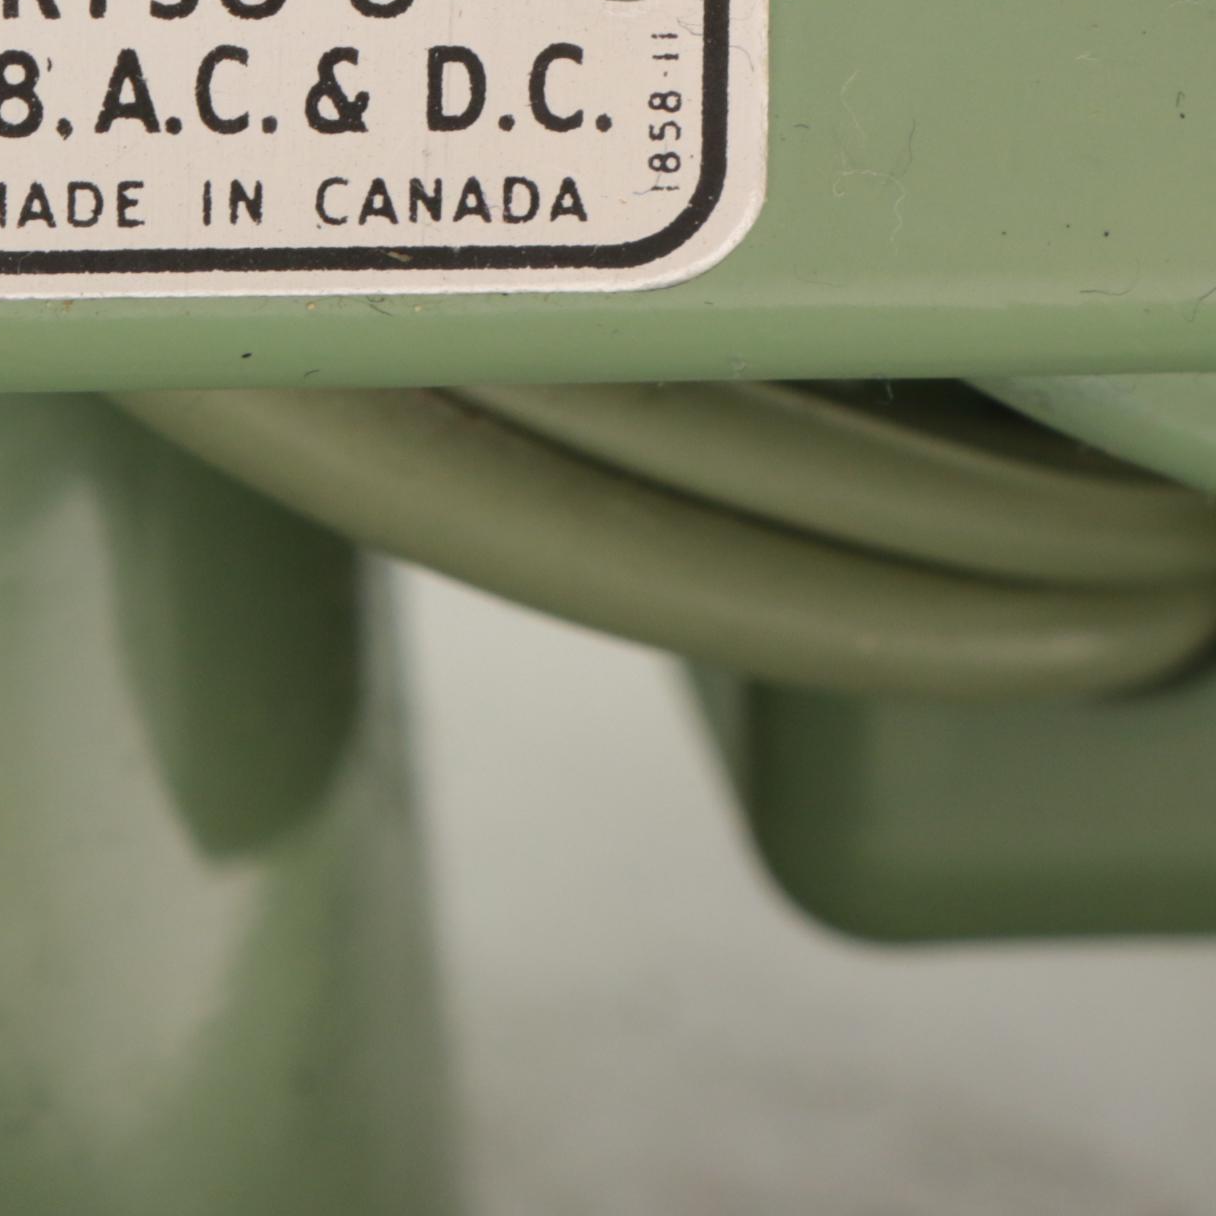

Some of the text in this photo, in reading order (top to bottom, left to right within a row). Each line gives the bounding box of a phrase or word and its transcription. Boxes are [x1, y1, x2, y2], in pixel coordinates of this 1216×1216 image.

[426, 42, 612, 133] D.C.
[202, 179, 263, 226] IN
[316, 176, 588, 226] CANADA
